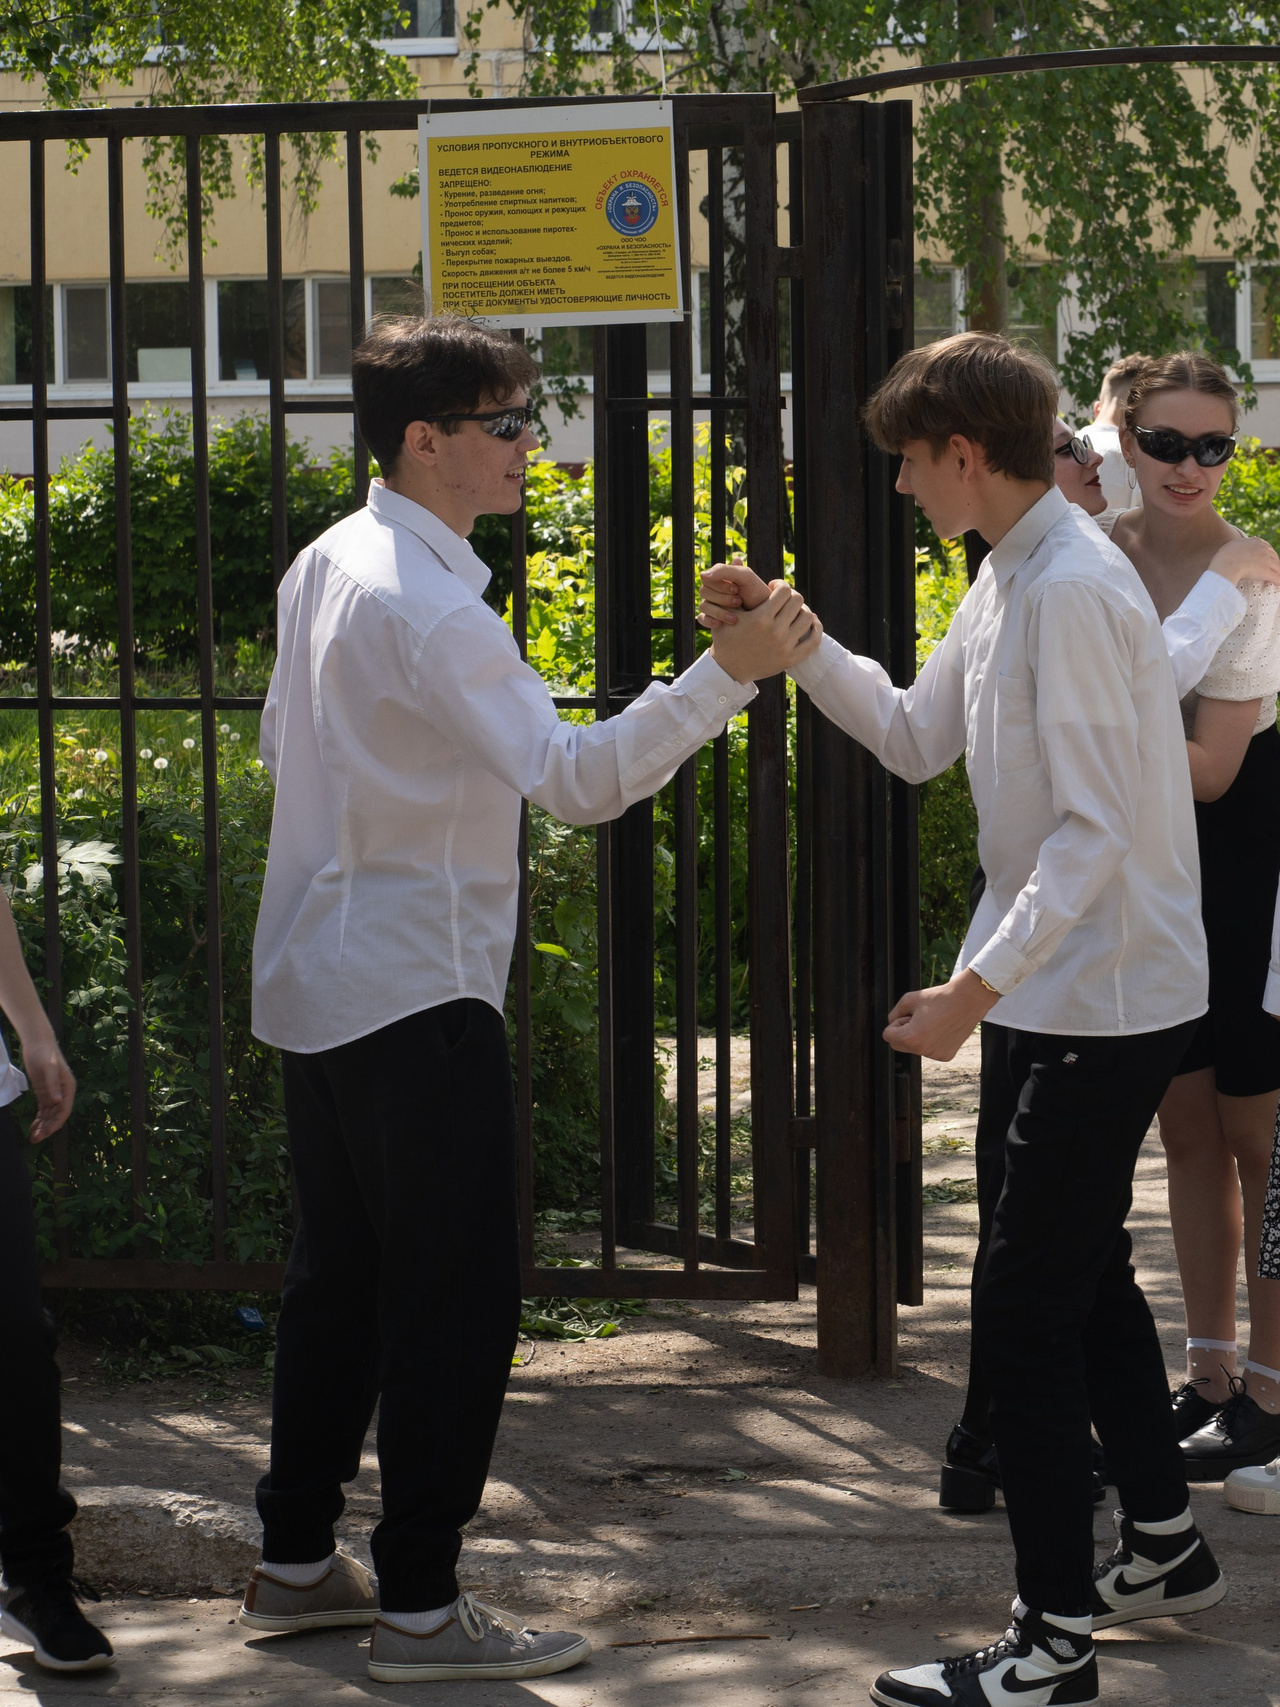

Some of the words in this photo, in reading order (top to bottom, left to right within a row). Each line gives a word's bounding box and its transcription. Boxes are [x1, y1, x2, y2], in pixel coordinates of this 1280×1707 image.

[437, 143, 480, 152] УСЛОВИЯ
[483, 141, 548, 150] ПРОПУСКНОГО
[560, 135, 664, 147] ВНУТРИОБЪЕКТОВОГО
[530, 150, 570, 158] РЕЖИМА
[439, 168, 479, 176] ВЕДЕТСЯ
[481, 164, 572, 175] ВИДЕОНАБЛЮДЕНИЕ
[439, 180, 492, 188] ЗАПРЕЩЕНО:
[595, 174, 618, 209] ОБЪЕКТ
[620, 170, 668, 207] ОХРАНЯЕТСЯ
[444, 191, 478, 199] Курение,
[480, 189, 524, 197] разведение
[445, 200, 497, 208] Употребление
[500, 198, 536, 206] спиртных
[539, 196, 577, 204] напитков;
[552, 206, 586, 214] режущих
[440, 219, 484, 228] предметов;
[445, 230, 473, 238] Пронос
[483, 227, 541, 236] использование
[478, 238, 512, 246] изделий;
[446, 249, 470, 257] Выгул
[472, 248, 496, 256] собак;
[446, 258, 492, 267] Перекрытие
[495, 257, 534, 265] пожарных
[536, 255, 572, 263] выездов.
[442, 270, 477, 278] Скорость
[480, 269, 517, 277] движения
[543, 266, 565, 274] более
[443, 282, 459, 290] ПРИ
[461, 280, 514, 289] ПОСЕЩЕНИИ
[443, 290, 497, 299] ПОСЕТИТЕЛЬ
[500, 288, 534, 297] ДОЛЖЕН
[443, 300, 459, 308] ПРИ
[486, 297, 538, 307] ДОКУМЕНТЫ
[540, 294, 623, 306] УДОСТОВЕРЯЮЩИЕ
[625, 293, 671, 302] ЛИЧНОСТЬ
